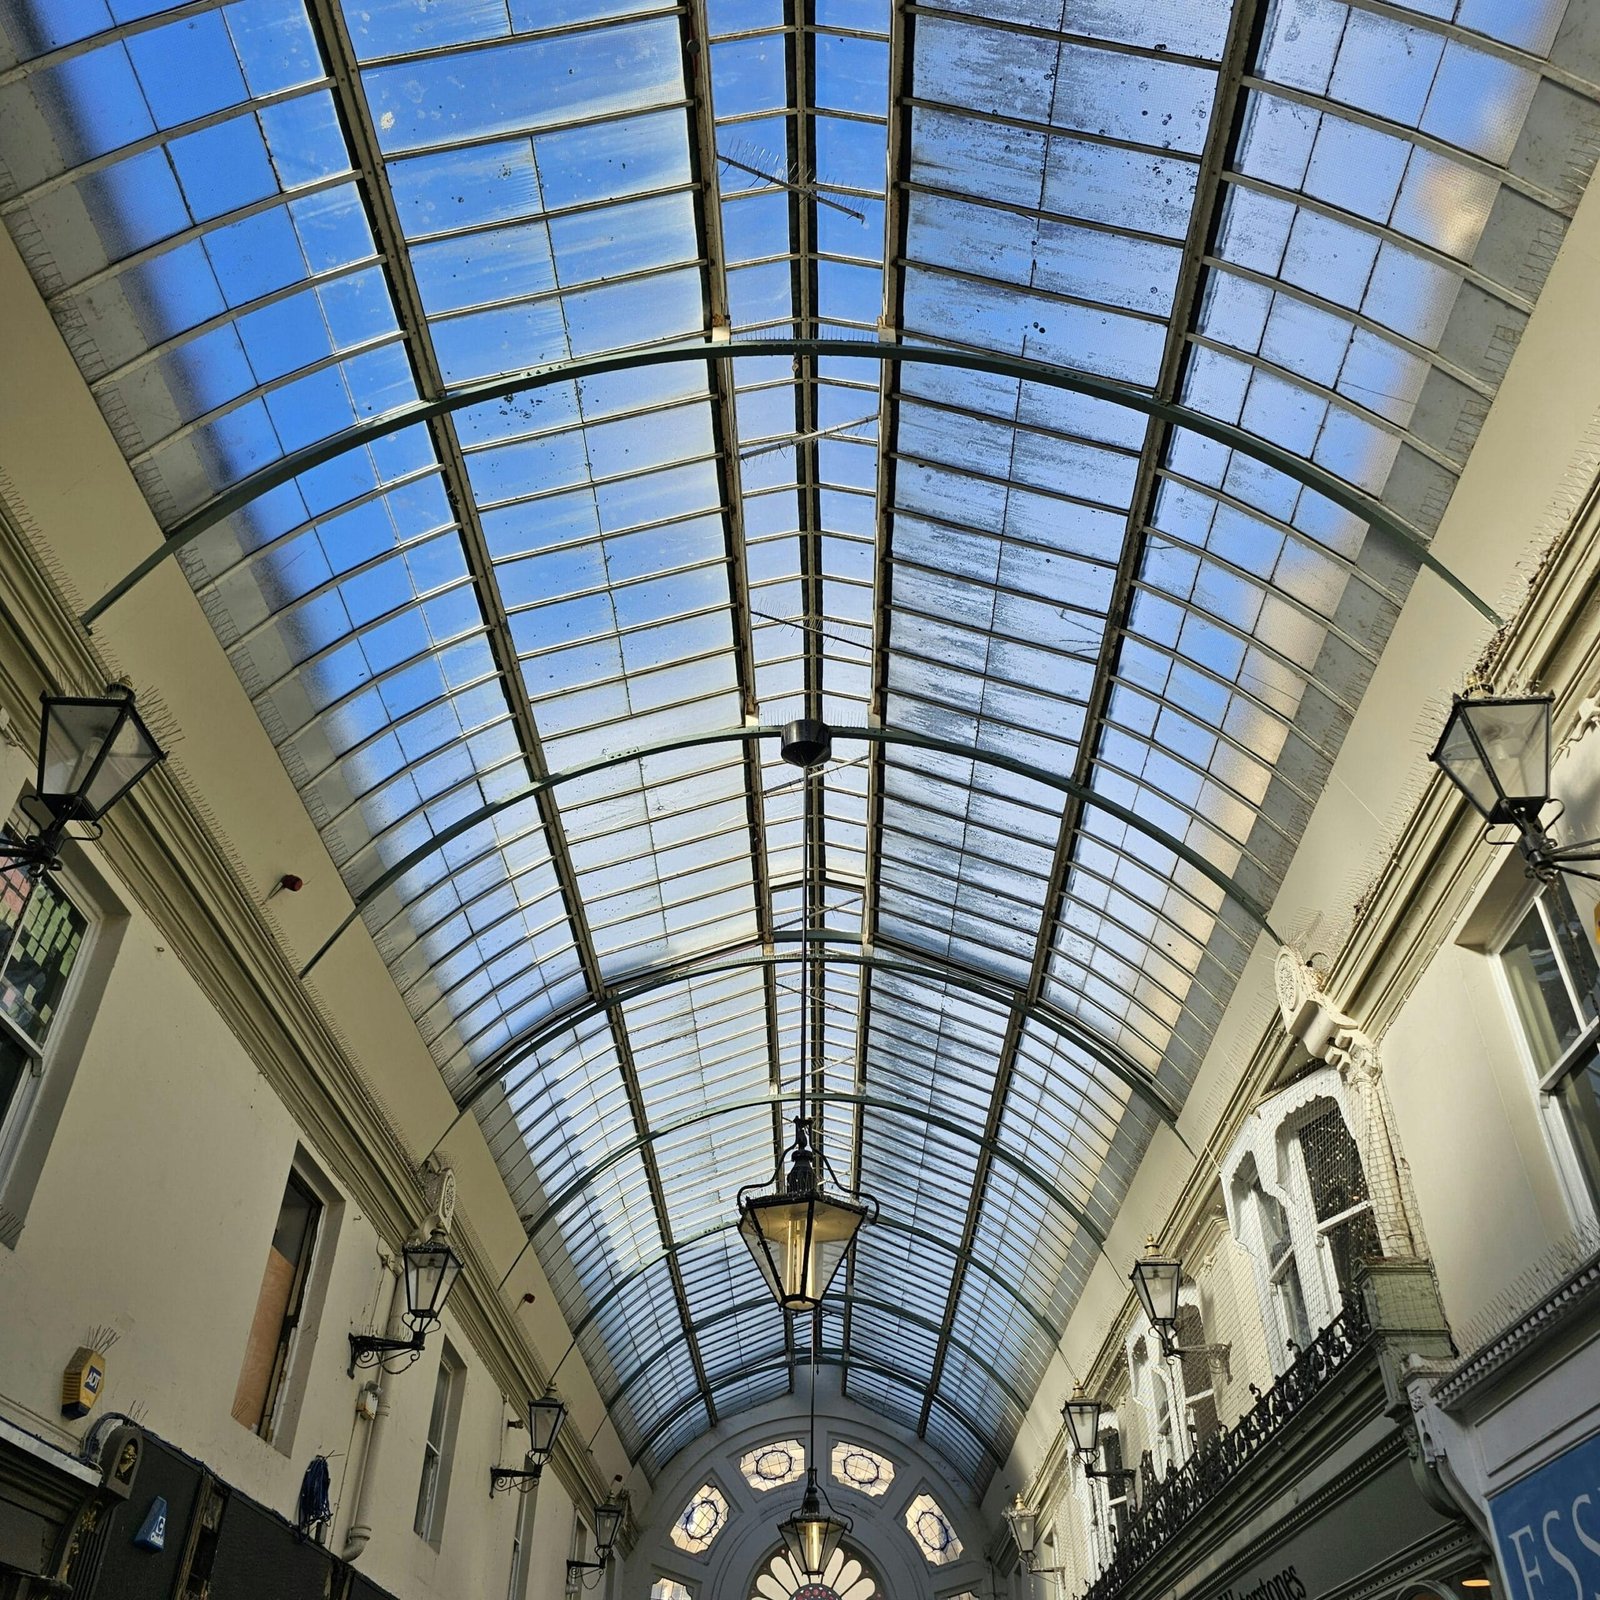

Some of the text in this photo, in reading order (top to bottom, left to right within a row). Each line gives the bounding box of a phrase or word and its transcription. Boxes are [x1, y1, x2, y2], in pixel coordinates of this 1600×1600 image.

[86, 1371, 101, 1389] ADT
[1508, 1488, 1600, 1600] ESS
[1217, 1565, 1306, 1600] stones
